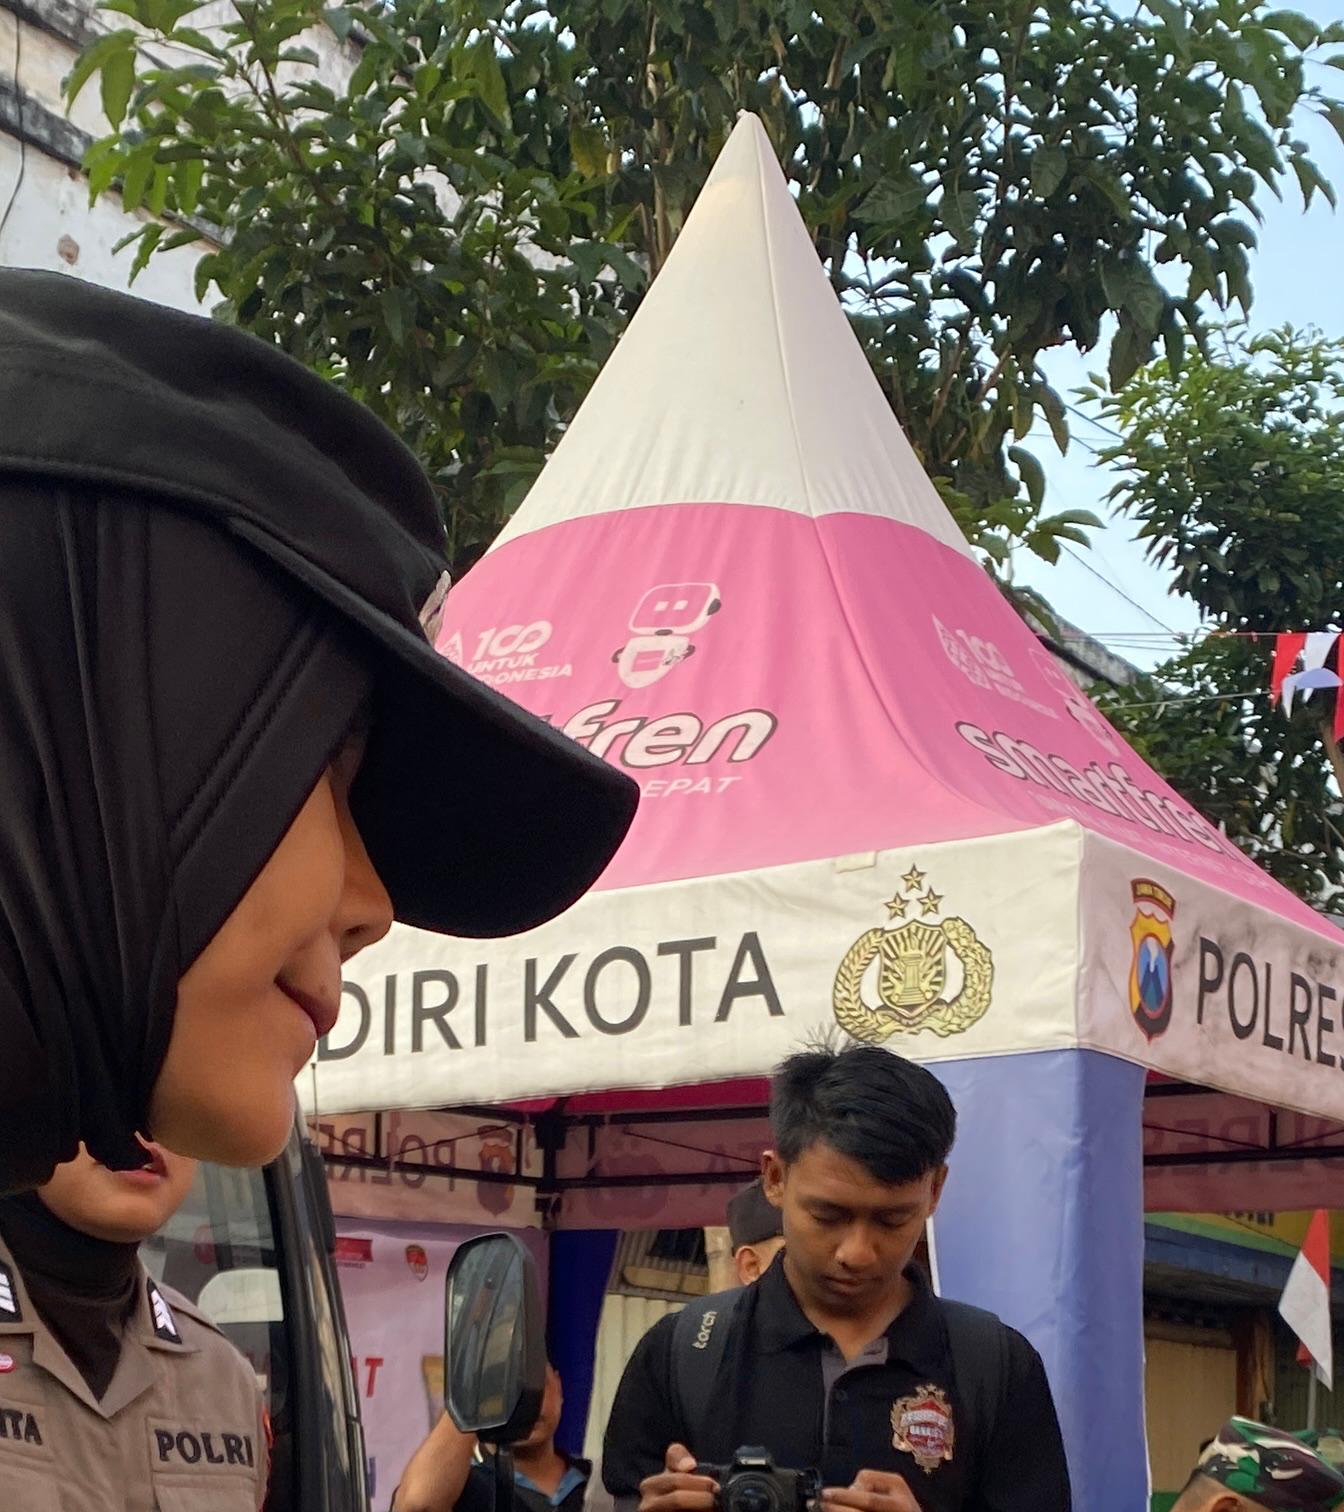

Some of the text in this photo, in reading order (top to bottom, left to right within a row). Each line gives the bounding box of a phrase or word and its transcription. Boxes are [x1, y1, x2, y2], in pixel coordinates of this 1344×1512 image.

[561, 699, 778, 769] fren
[640, 776, 742, 798] EPAT
[524, 931, 786, 1044] KOTA
[154, 1428, 255, 1468] POLRI
